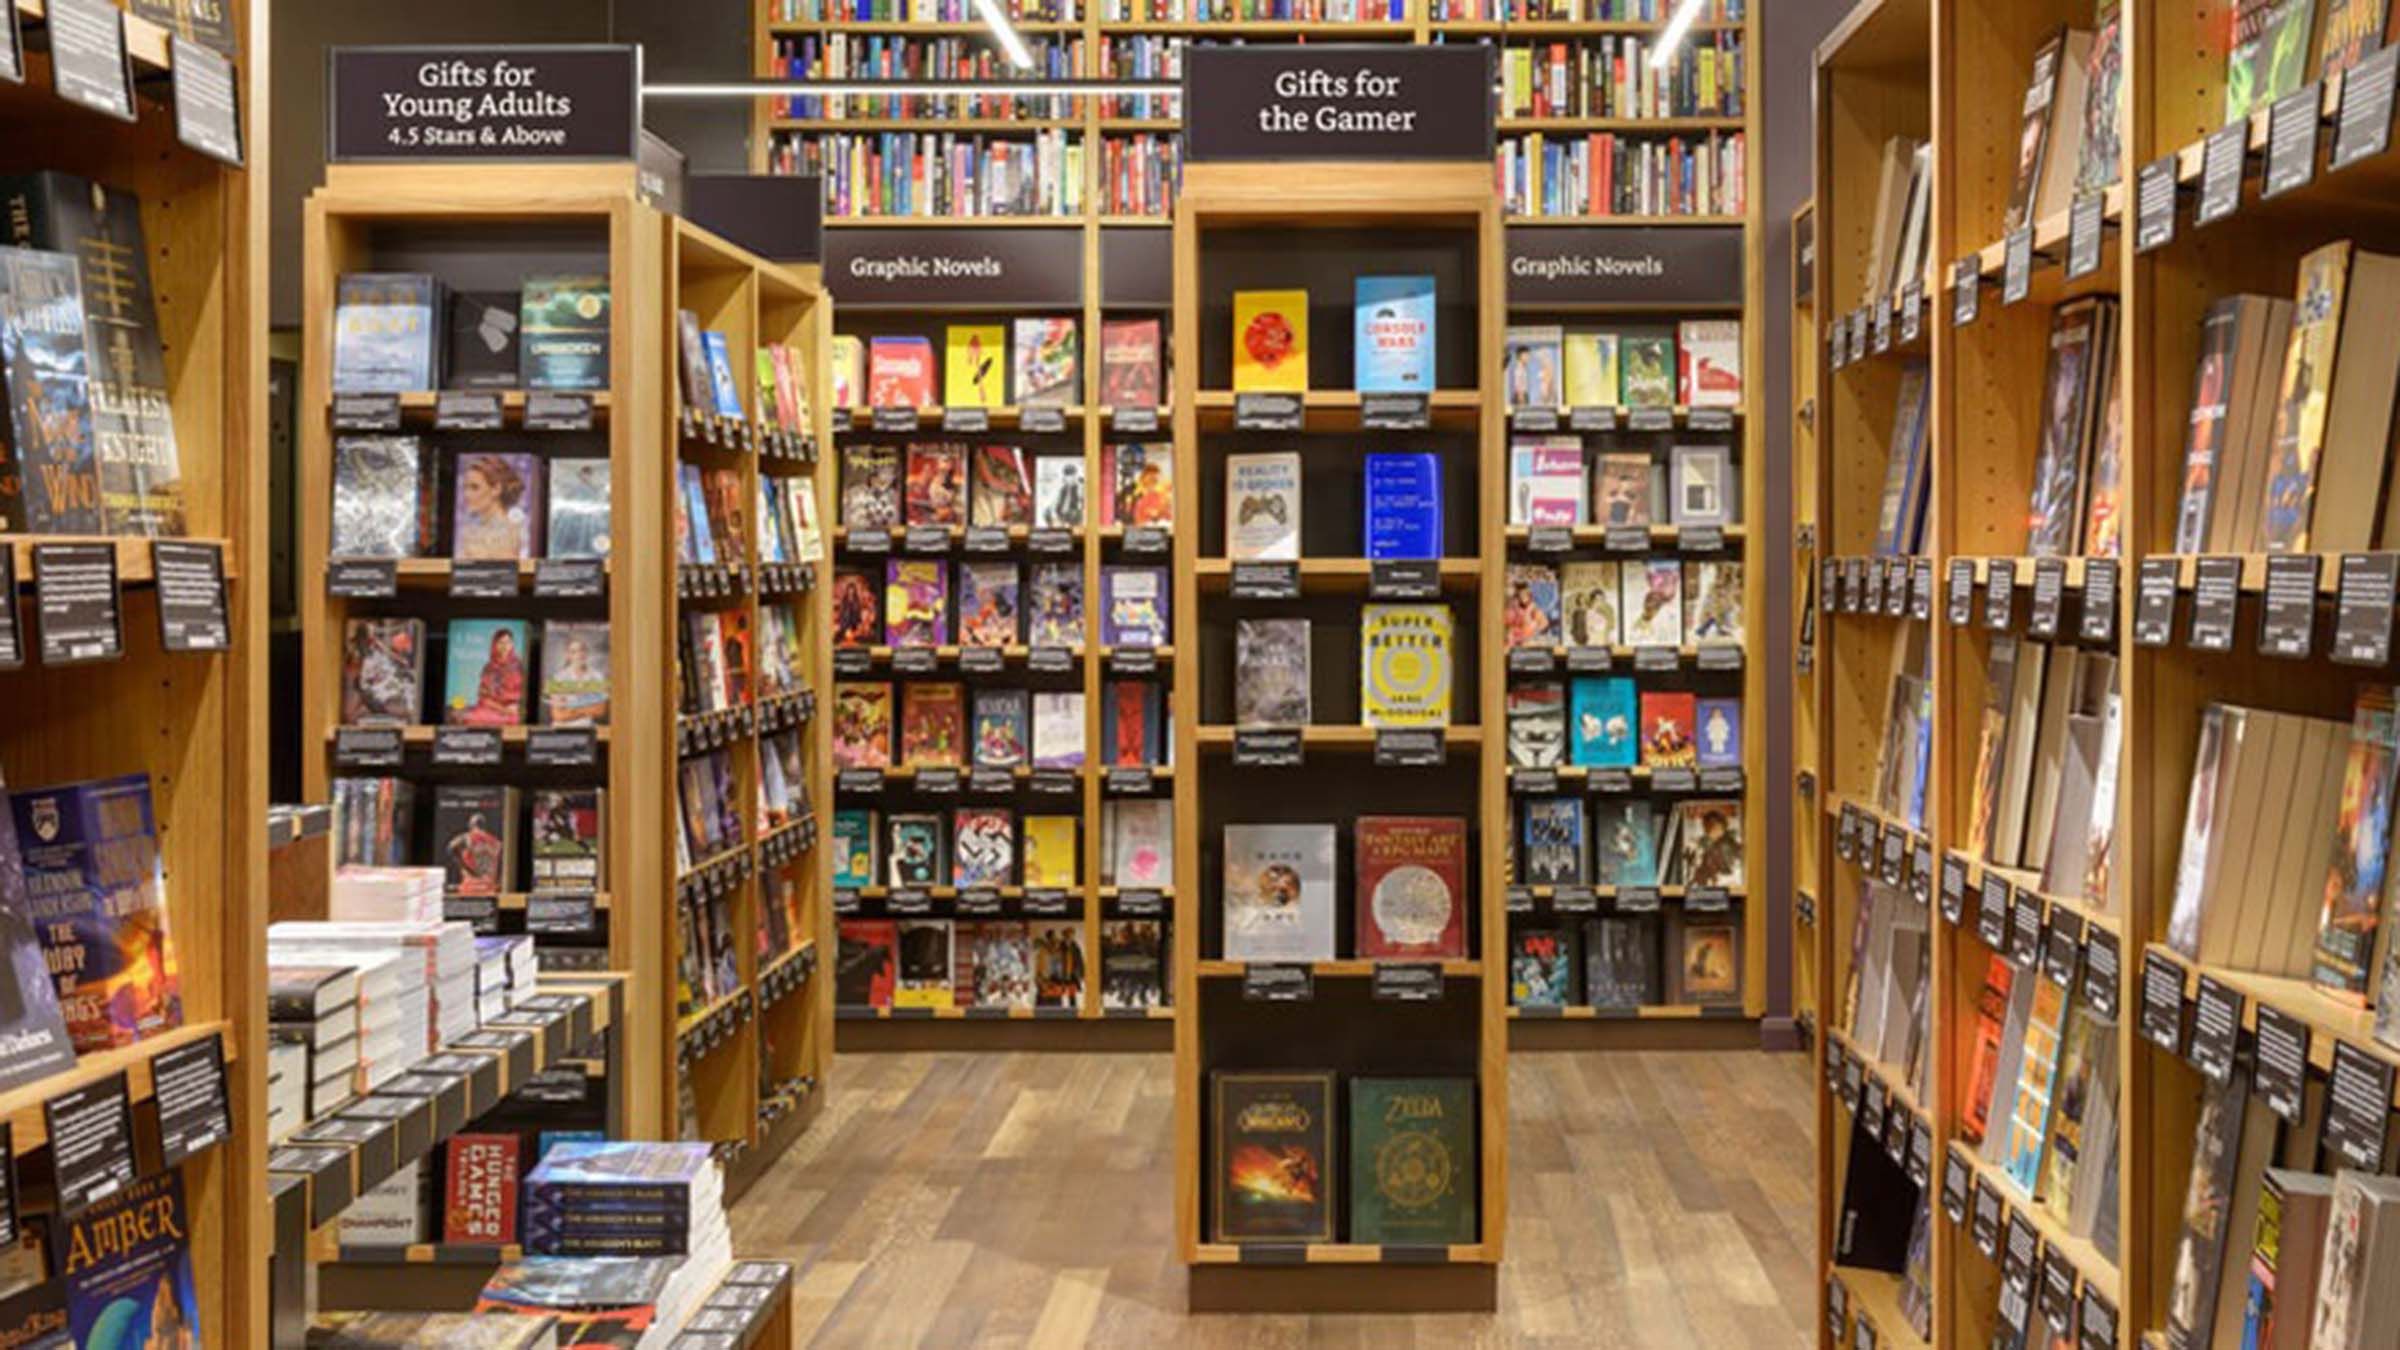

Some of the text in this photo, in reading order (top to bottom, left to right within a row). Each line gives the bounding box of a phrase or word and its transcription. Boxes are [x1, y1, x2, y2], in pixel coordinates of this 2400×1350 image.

[418, 61, 535, 87] Gifts for
[1275, 70, 1400, 97] Gifts for
[382, 93, 571, 122] Young Adults
[1259, 106, 1416, 132] the Gamer
[388, 126, 566, 145] 4.5 Stars & Above
[850, 257, 1001, 280] Graphic Novels
[1511, 257, 1663, 280] Graphic Novels
[1377, 335, 1416, 349] WARS
[1378, 614, 1434, 628] SUPER
[1385, 1095, 1443, 1127] ZELDA
[467, 1144, 486, 1236] GAMES
[485, 1144, 503, 1236] HUNGER
[65, 1194, 183, 1275] AMBER
